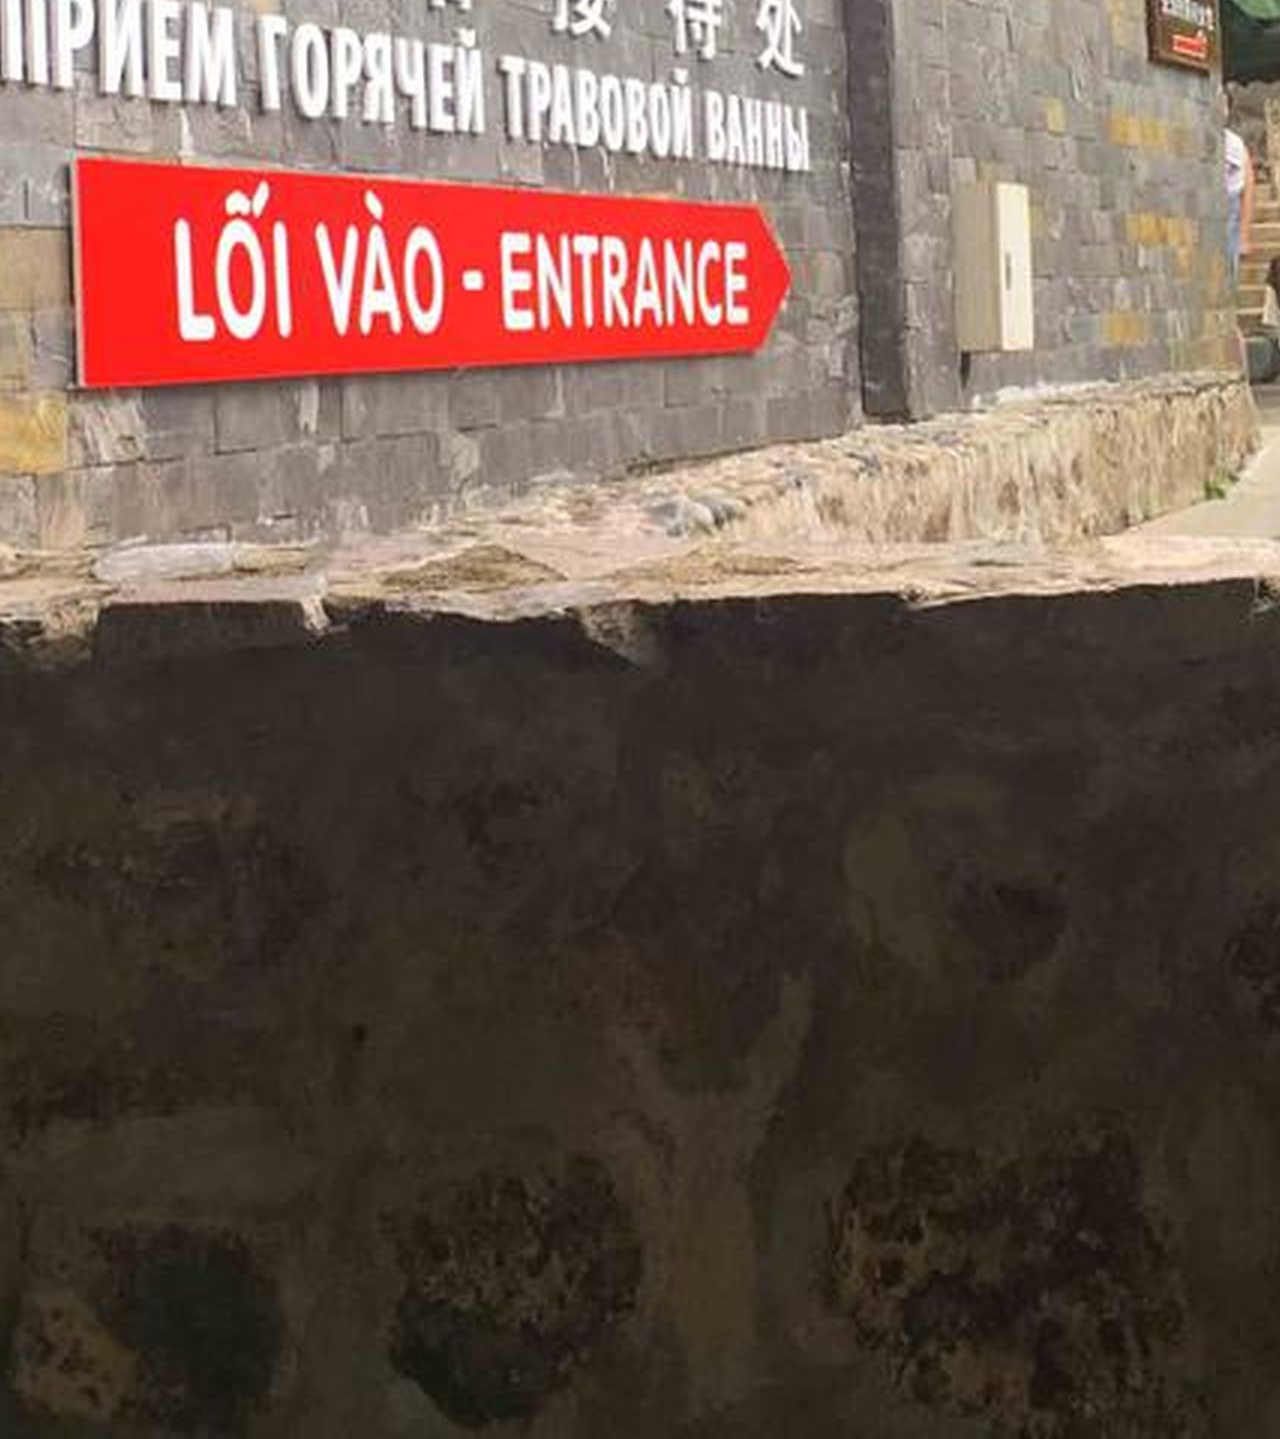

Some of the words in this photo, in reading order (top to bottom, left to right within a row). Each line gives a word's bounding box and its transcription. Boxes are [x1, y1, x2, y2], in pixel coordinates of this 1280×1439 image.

[257, 14, 486, 137] ГОРЯЧЕЙ
[498, 55, 693, 161] ТРАВОВОЙ
[703, 89, 811, 172] ВАННЫ
[174, 179, 292, 342] LỐI
[315, 189, 444, 336] VÀO
[462, 269, 484, 292] -
[501, 230, 750, 334] ENTRANCE
